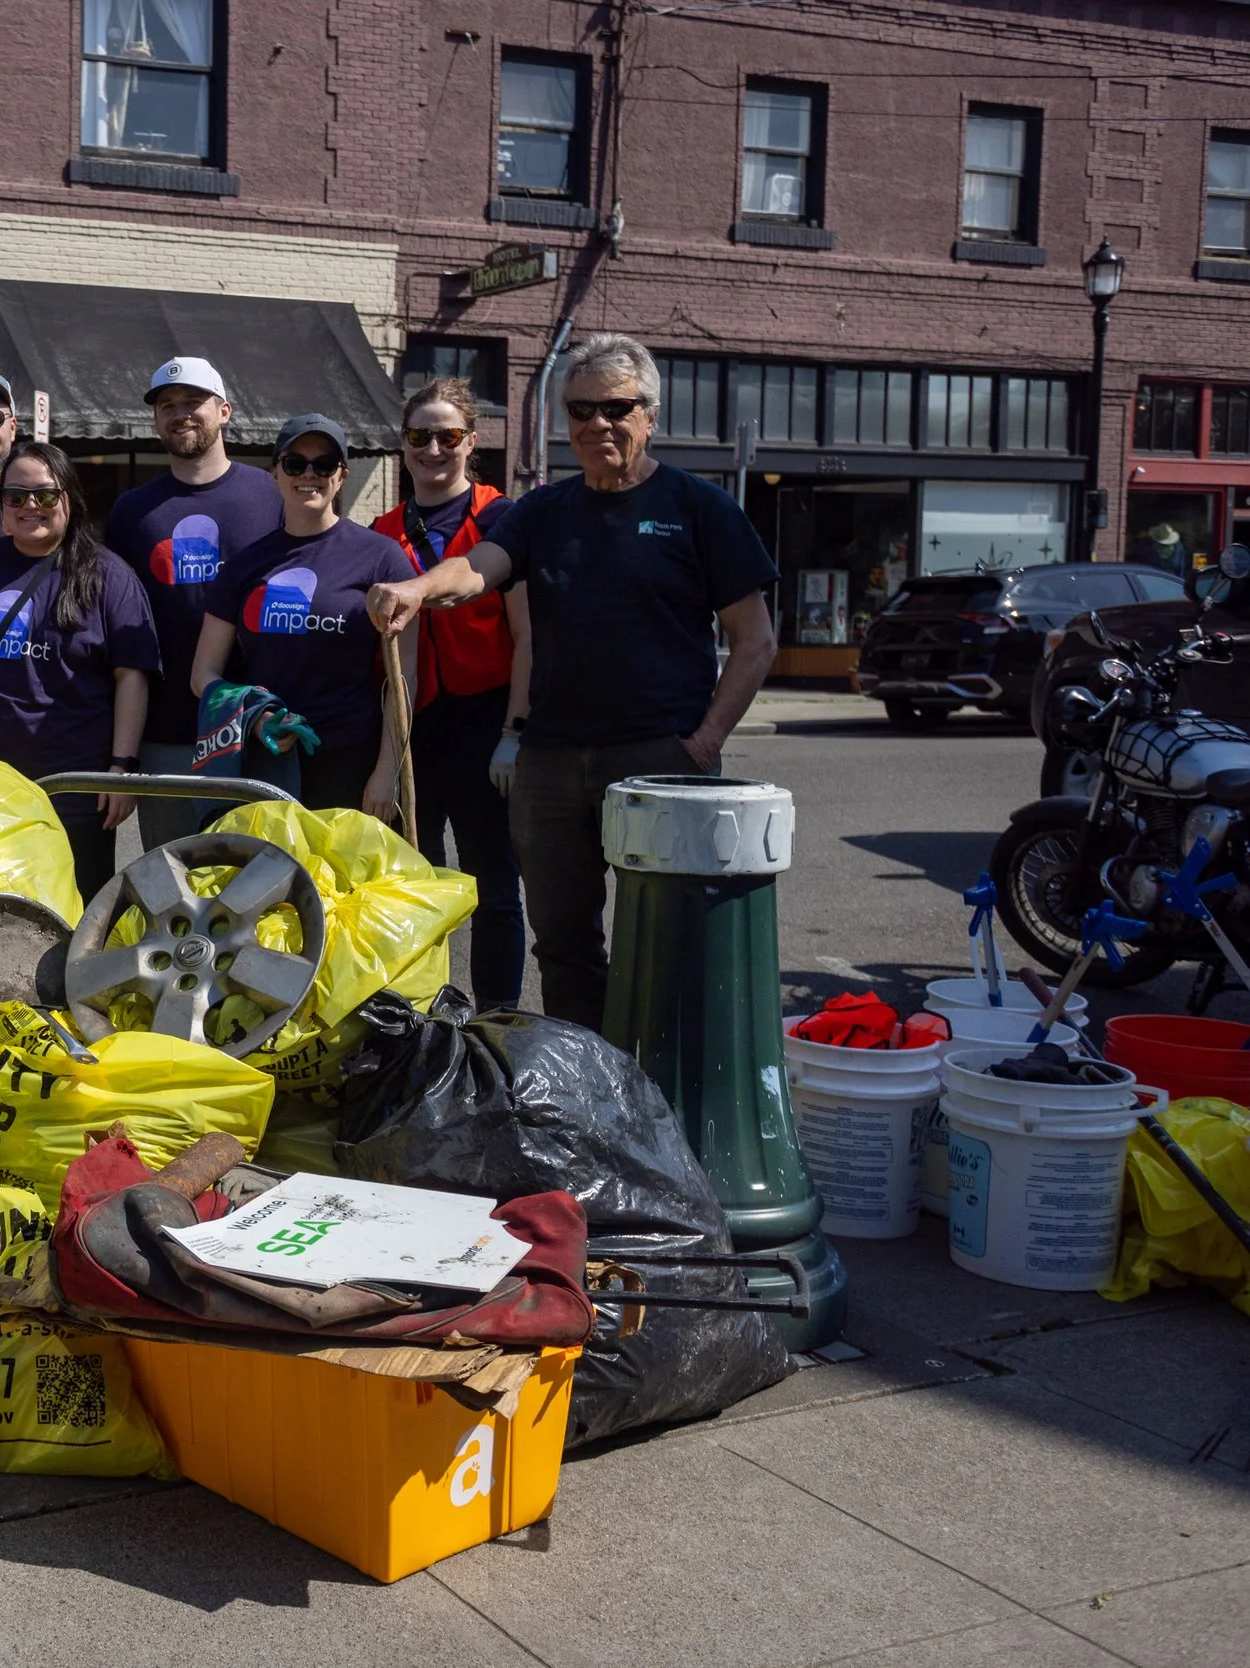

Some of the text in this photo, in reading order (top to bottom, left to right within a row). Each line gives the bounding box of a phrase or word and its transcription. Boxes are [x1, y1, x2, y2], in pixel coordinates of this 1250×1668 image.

[178, 559, 225, 582] Imp
[263, 606, 347, 634] Impact
[278, 603, 305, 611] docusign
[226, 1200, 288, 1231] Welcome
[256, 1219, 342, 1256] SEA
[450, 1423, 496, 1508] a
